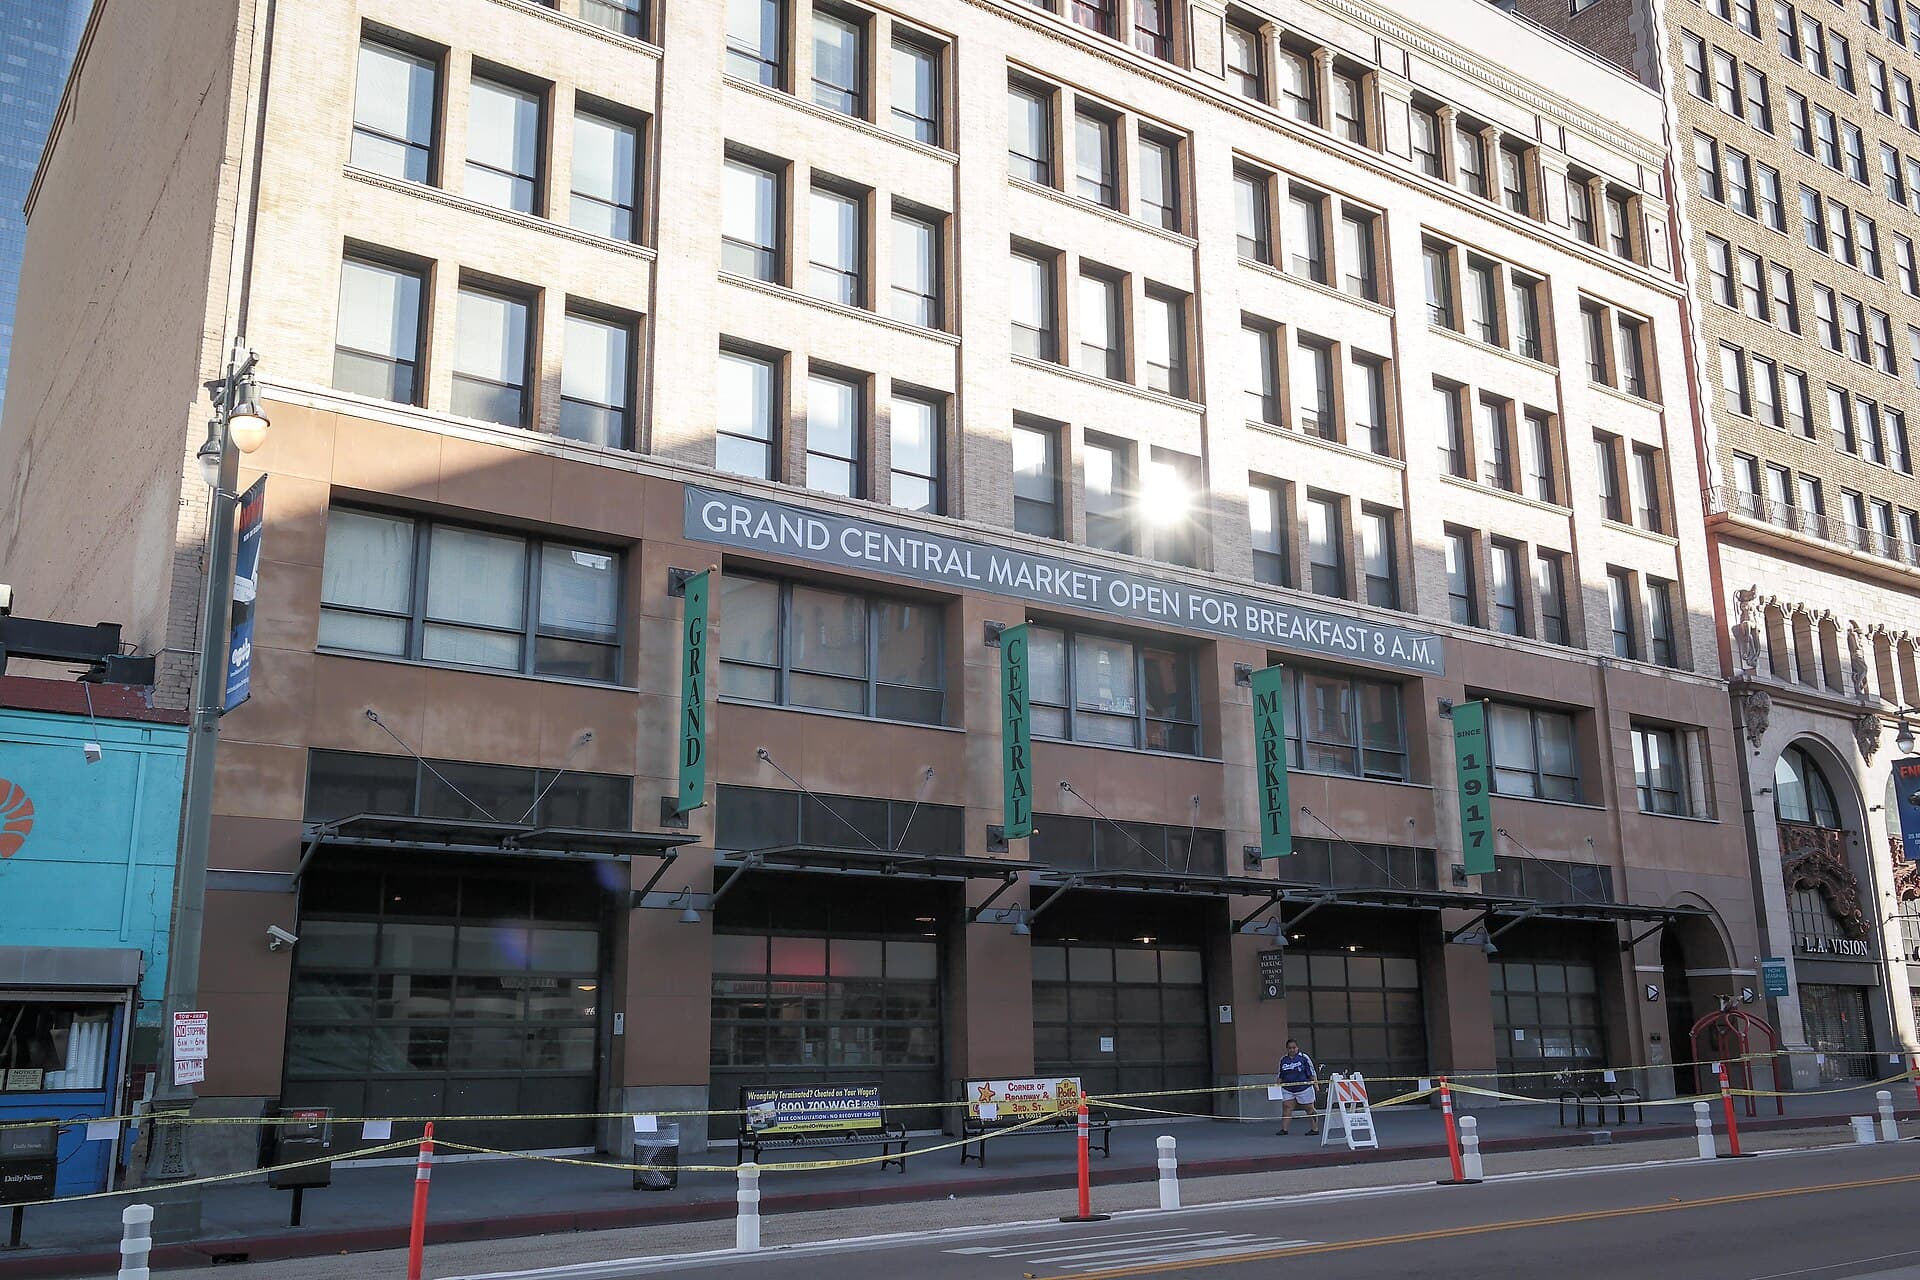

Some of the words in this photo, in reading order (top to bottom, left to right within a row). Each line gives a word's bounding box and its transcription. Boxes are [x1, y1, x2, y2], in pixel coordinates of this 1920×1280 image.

[702, 500, 830, 551] GRAND
[840, 527, 981, 581] CENTRAL
[988, 555, 1102, 602] MARKET
[1108, 580, 1180, 618] OPEN
[1189, 596, 1238, 629] FOR
[1246, 606, 1368, 652] BREAKFAST
[1374, 632, 1386, 656] 8
[1391, 635, 1435, 665] A.M.
[686, 617, 702, 767] GRAND
[1007, 639, 1027, 826] CENTRAL
[1457, 728, 1481, 738] SINCE
[1256, 689, 1281, 835] MARKET
[1462, 753, 1486, 848] 1917
[1806, 937, 1829, 953] L.A.
[1832, 939, 1869, 955] VISION
[176, 1025, 186, 1037] NO
[187, 1027, 206, 1036] STOPPING
[177, 1061, 189, 1072] ANY
[191, 1060, 203, 1070] TIME
[1008, 1083, 1035, 1091] CORNER
[1057, 1087, 1077, 1098] Pollo
[747, 1091, 779, 1102] Wrongfully
[780, 1089, 814, 1099] Terminated?
[814, 1089, 835, 1097] Cheated
[844, 1088, 856, 1096] Your
[857, 1087, 878, 1097] Wages?
[1005, 1093, 1040, 1101] BROADWAY
[777, 1101, 805, 1114] (800)
[1012, 1104, 1030, 1112] 3RD.
[1032, 1102, 1045, 1111] ST.
[4, 1174, 24, 1183] Daily
